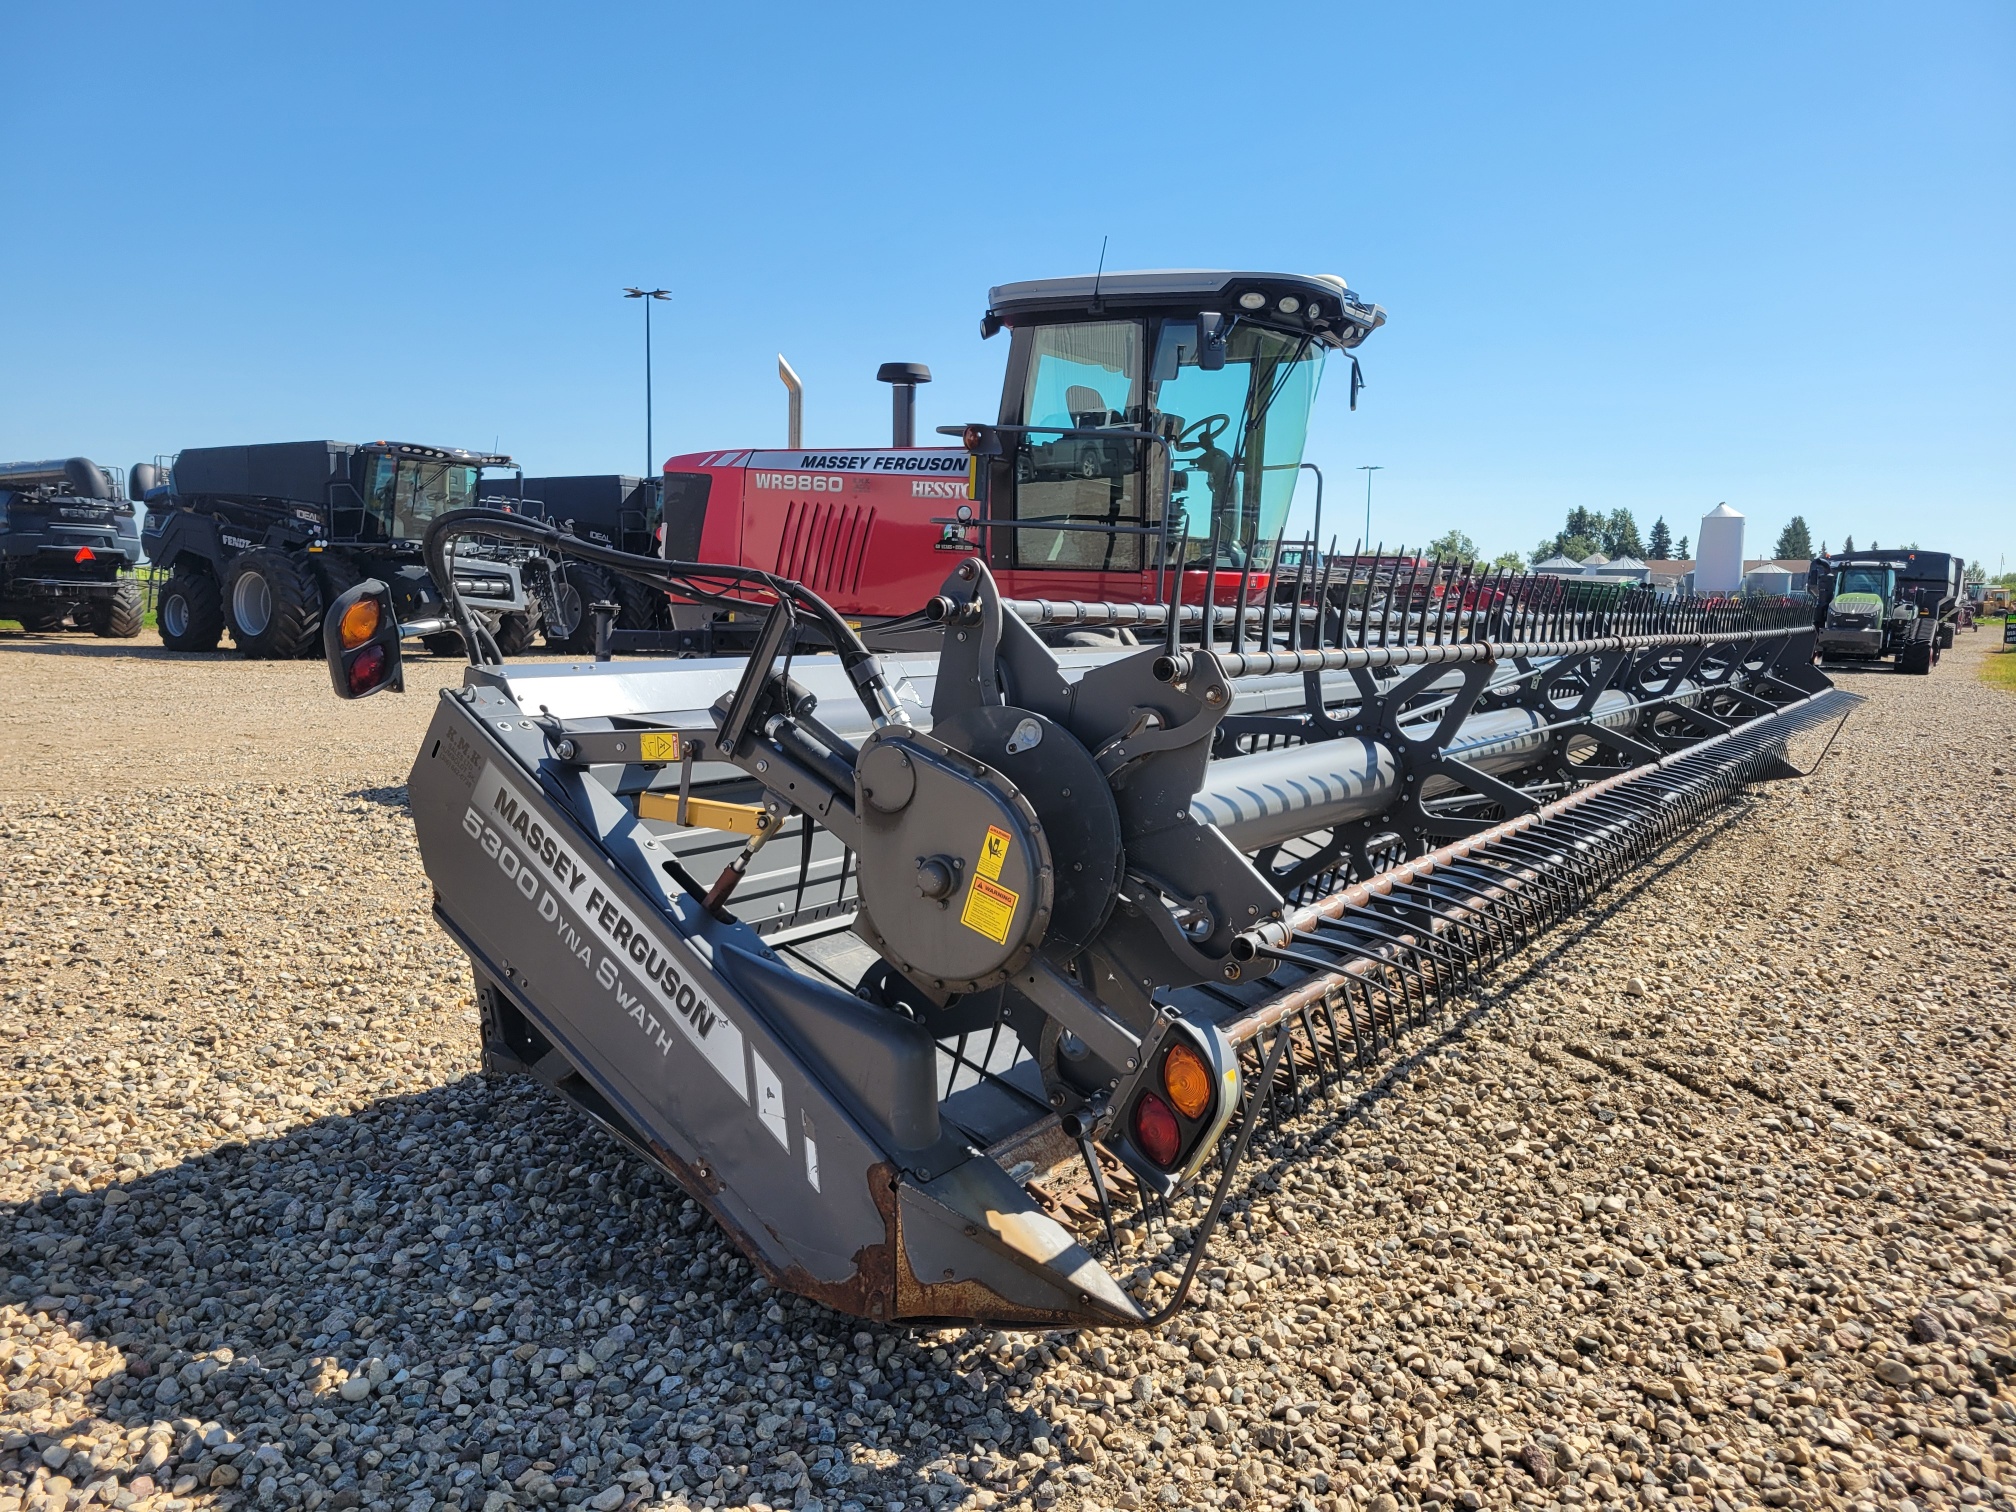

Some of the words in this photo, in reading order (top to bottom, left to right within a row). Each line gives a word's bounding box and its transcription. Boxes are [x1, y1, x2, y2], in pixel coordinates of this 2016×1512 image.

[801, 455, 870, 470] MASSEY
[873, 457, 968, 472] FERGUSON
[755, 473, 843, 493] WR9860
[60, 507, 110, 519] FENDT
[296, 509, 320, 523] IDEAL
[223, 534, 251, 549] FENDT
[590, 531, 611, 543] IDEAL
[462, 806, 539, 900] 5300
[984, 885, 1012, 904] WARNING
[494, 786, 586, 895] MASSEY
[585, 886, 717, 1041] FERGUSON
